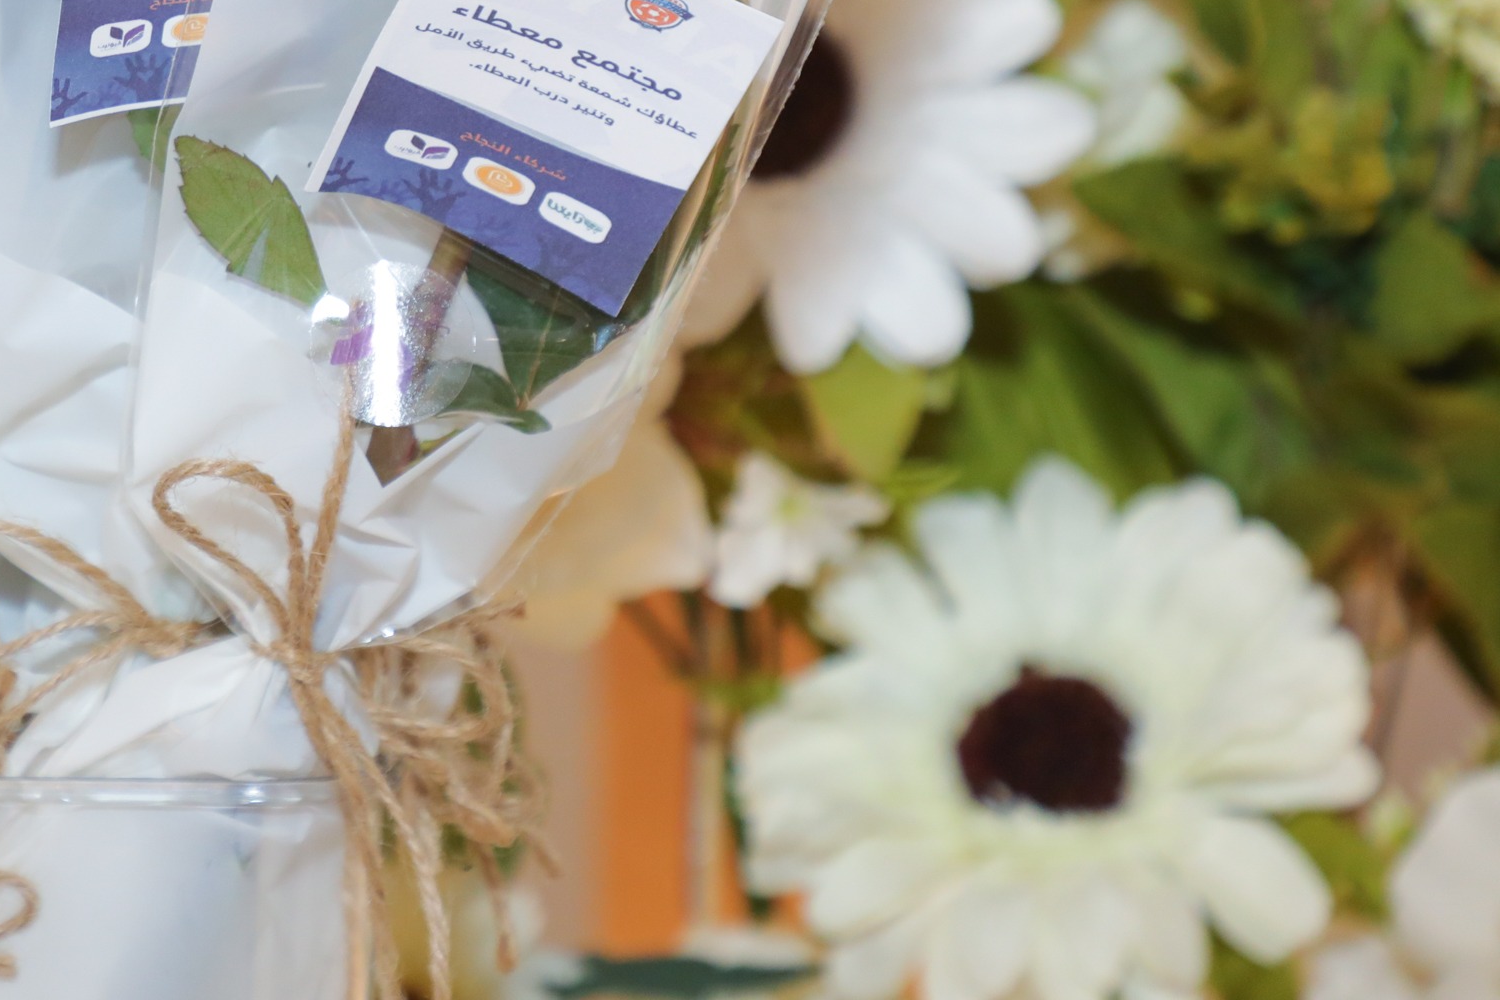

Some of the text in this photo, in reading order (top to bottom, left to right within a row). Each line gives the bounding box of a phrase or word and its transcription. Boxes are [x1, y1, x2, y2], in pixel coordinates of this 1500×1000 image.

[415, 22, 698, 140] عطاؤك شمعة تضيء طريق الأمل
[452, 4, 683, 101] مجتمع معطاء
[533, 85, 569, 105] درب
[572, 100, 616, 127] وتنير
